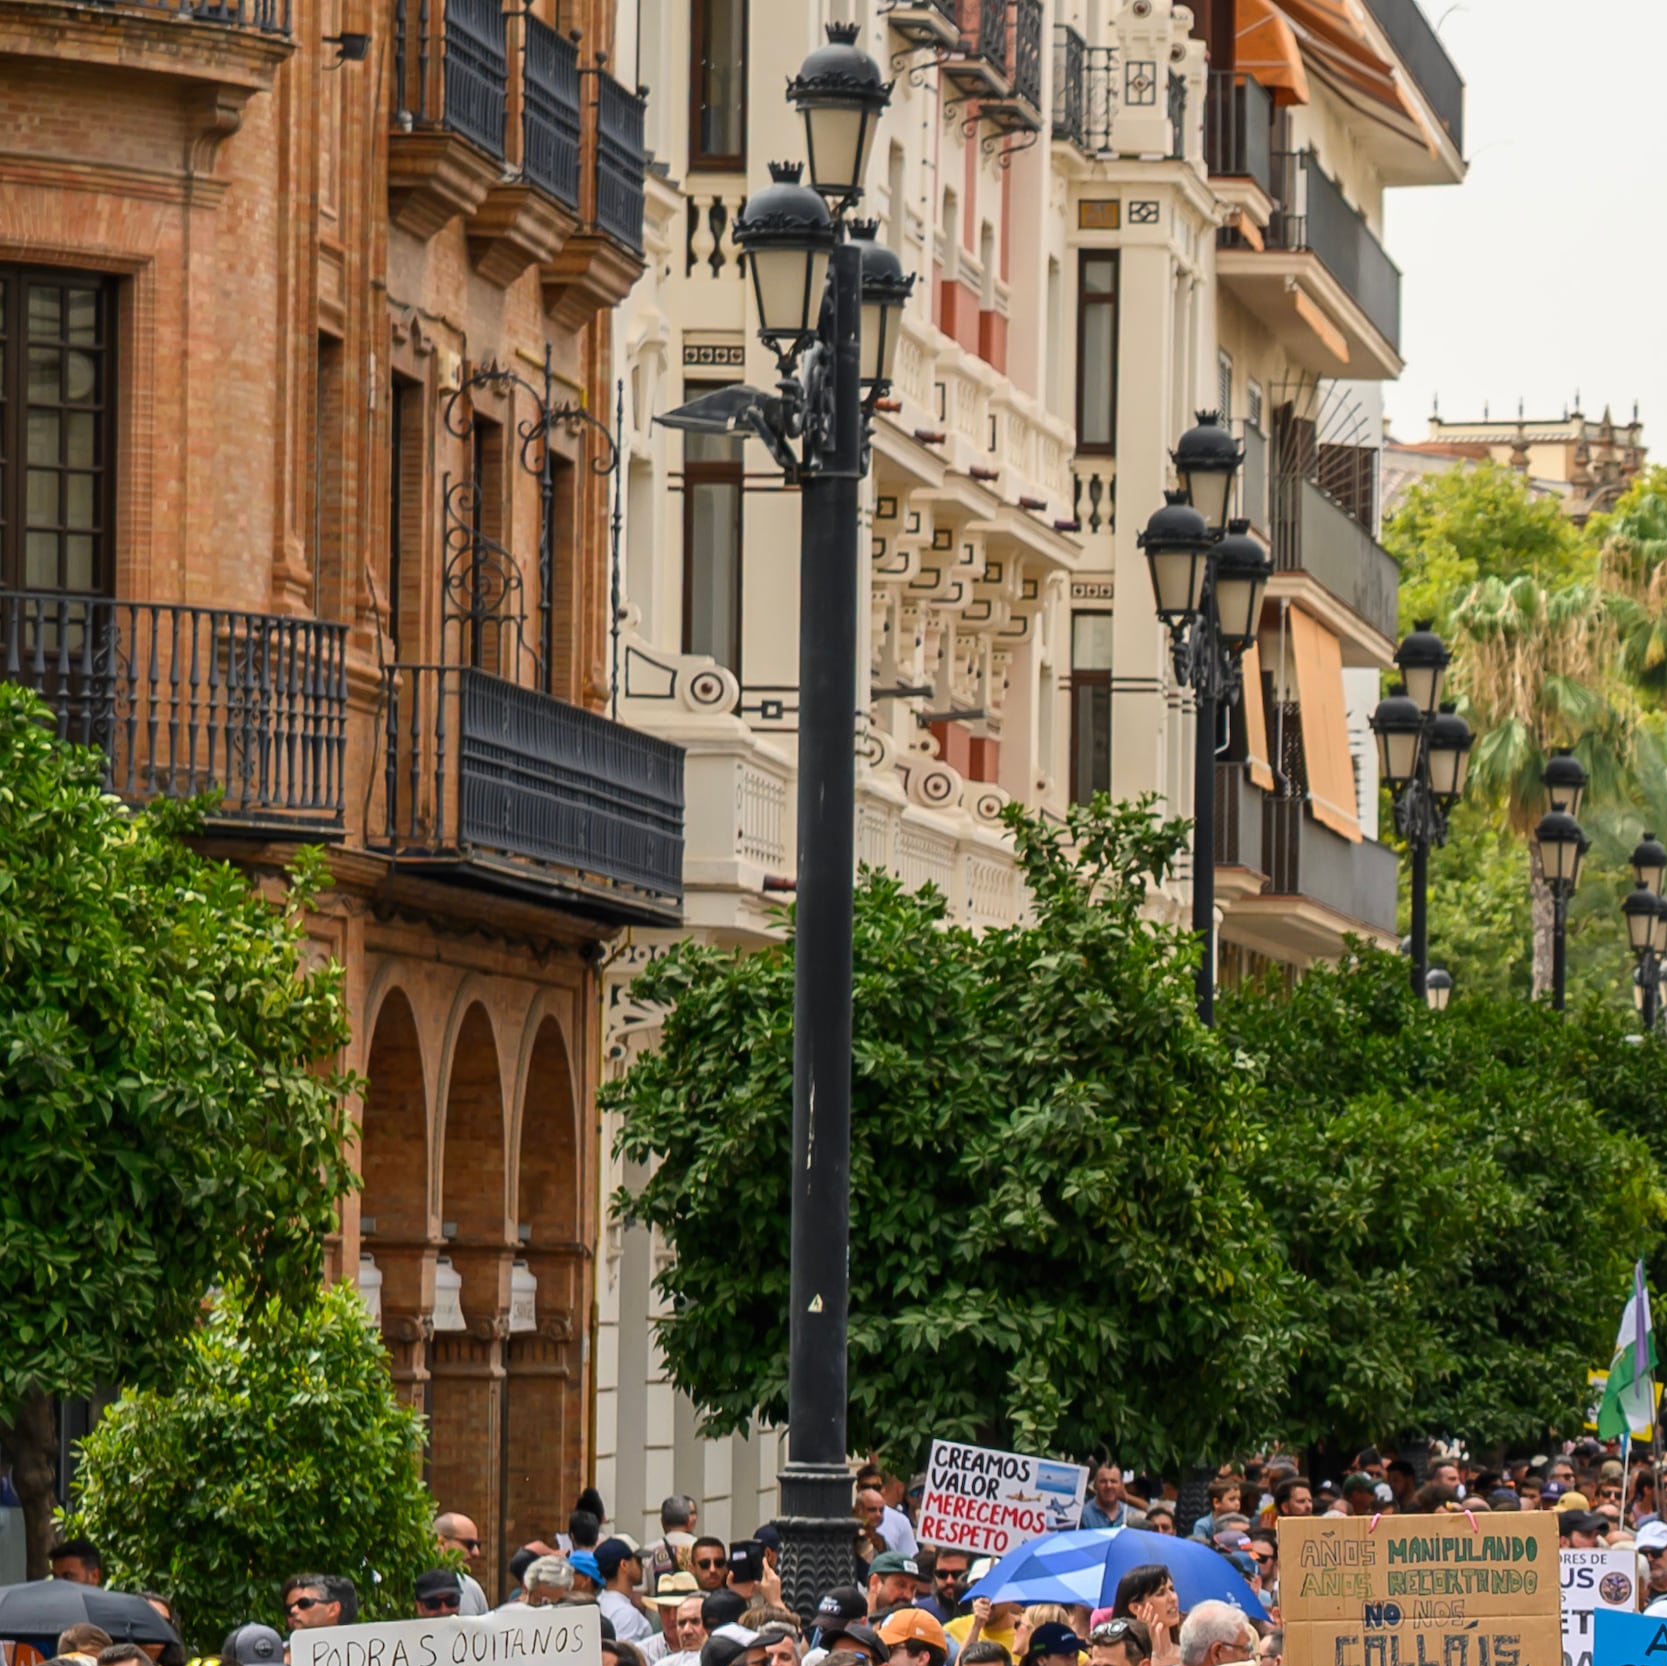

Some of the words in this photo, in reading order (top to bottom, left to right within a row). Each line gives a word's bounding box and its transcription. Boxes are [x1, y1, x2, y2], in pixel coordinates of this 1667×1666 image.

[935, 1445, 1030, 1482] CREAMOS
[932, 1468, 1000, 1501] VALOR
[925, 1492, 1045, 1534] MERECEMOS
[922, 1516, 1008, 1552] RESPETO
[1300, 1530, 1375, 1567] AÑOS
[1590, 1554, 1607, 1565] DE
[1300, 1567, 1374, 1598] AÑOS
[1387, 1568, 1538, 1596] RECORTANDO
[1362, 1600, 1405, 1632] NO
[1412, 1599, 1465, 1628] NOS
[452, 1624, 584, 1665] QUITANOS
